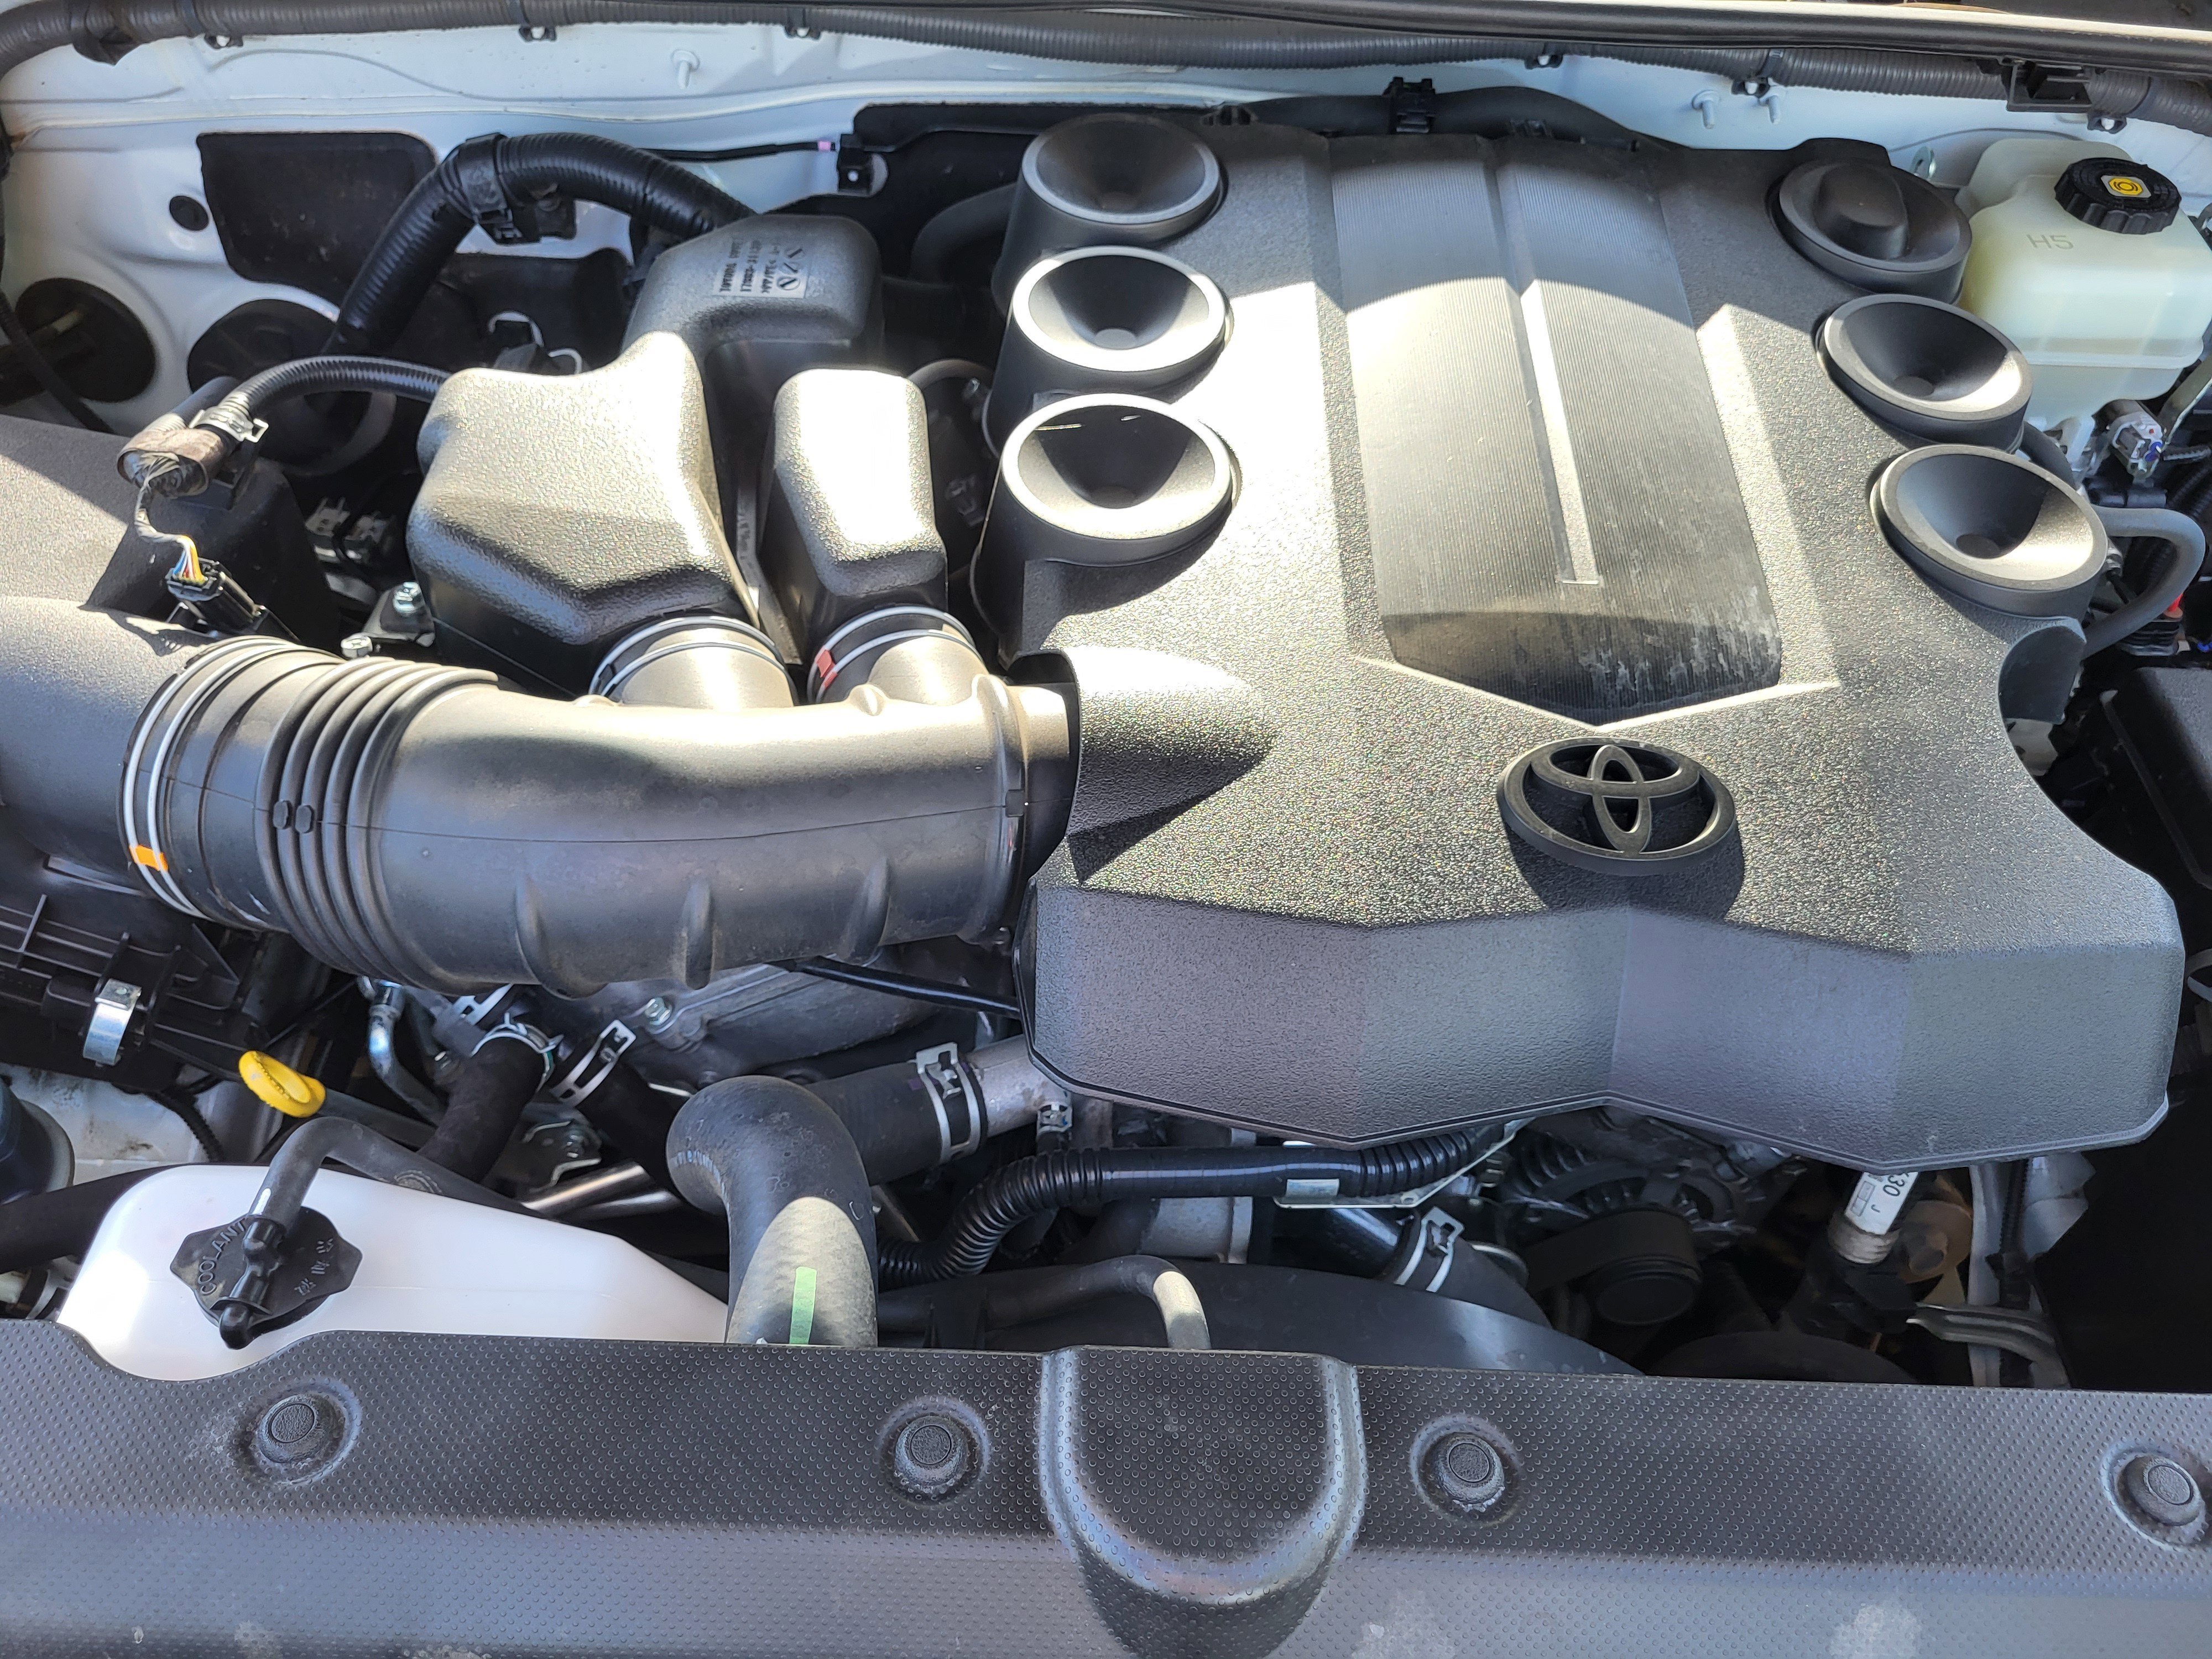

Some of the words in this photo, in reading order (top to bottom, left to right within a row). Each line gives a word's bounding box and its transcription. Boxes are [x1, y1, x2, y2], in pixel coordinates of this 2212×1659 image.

[2026, 234, 2073, 249] H5
[1884, 1172, 1910, 1197] 30
[197, 1218, 246, 1295] COOLANT
